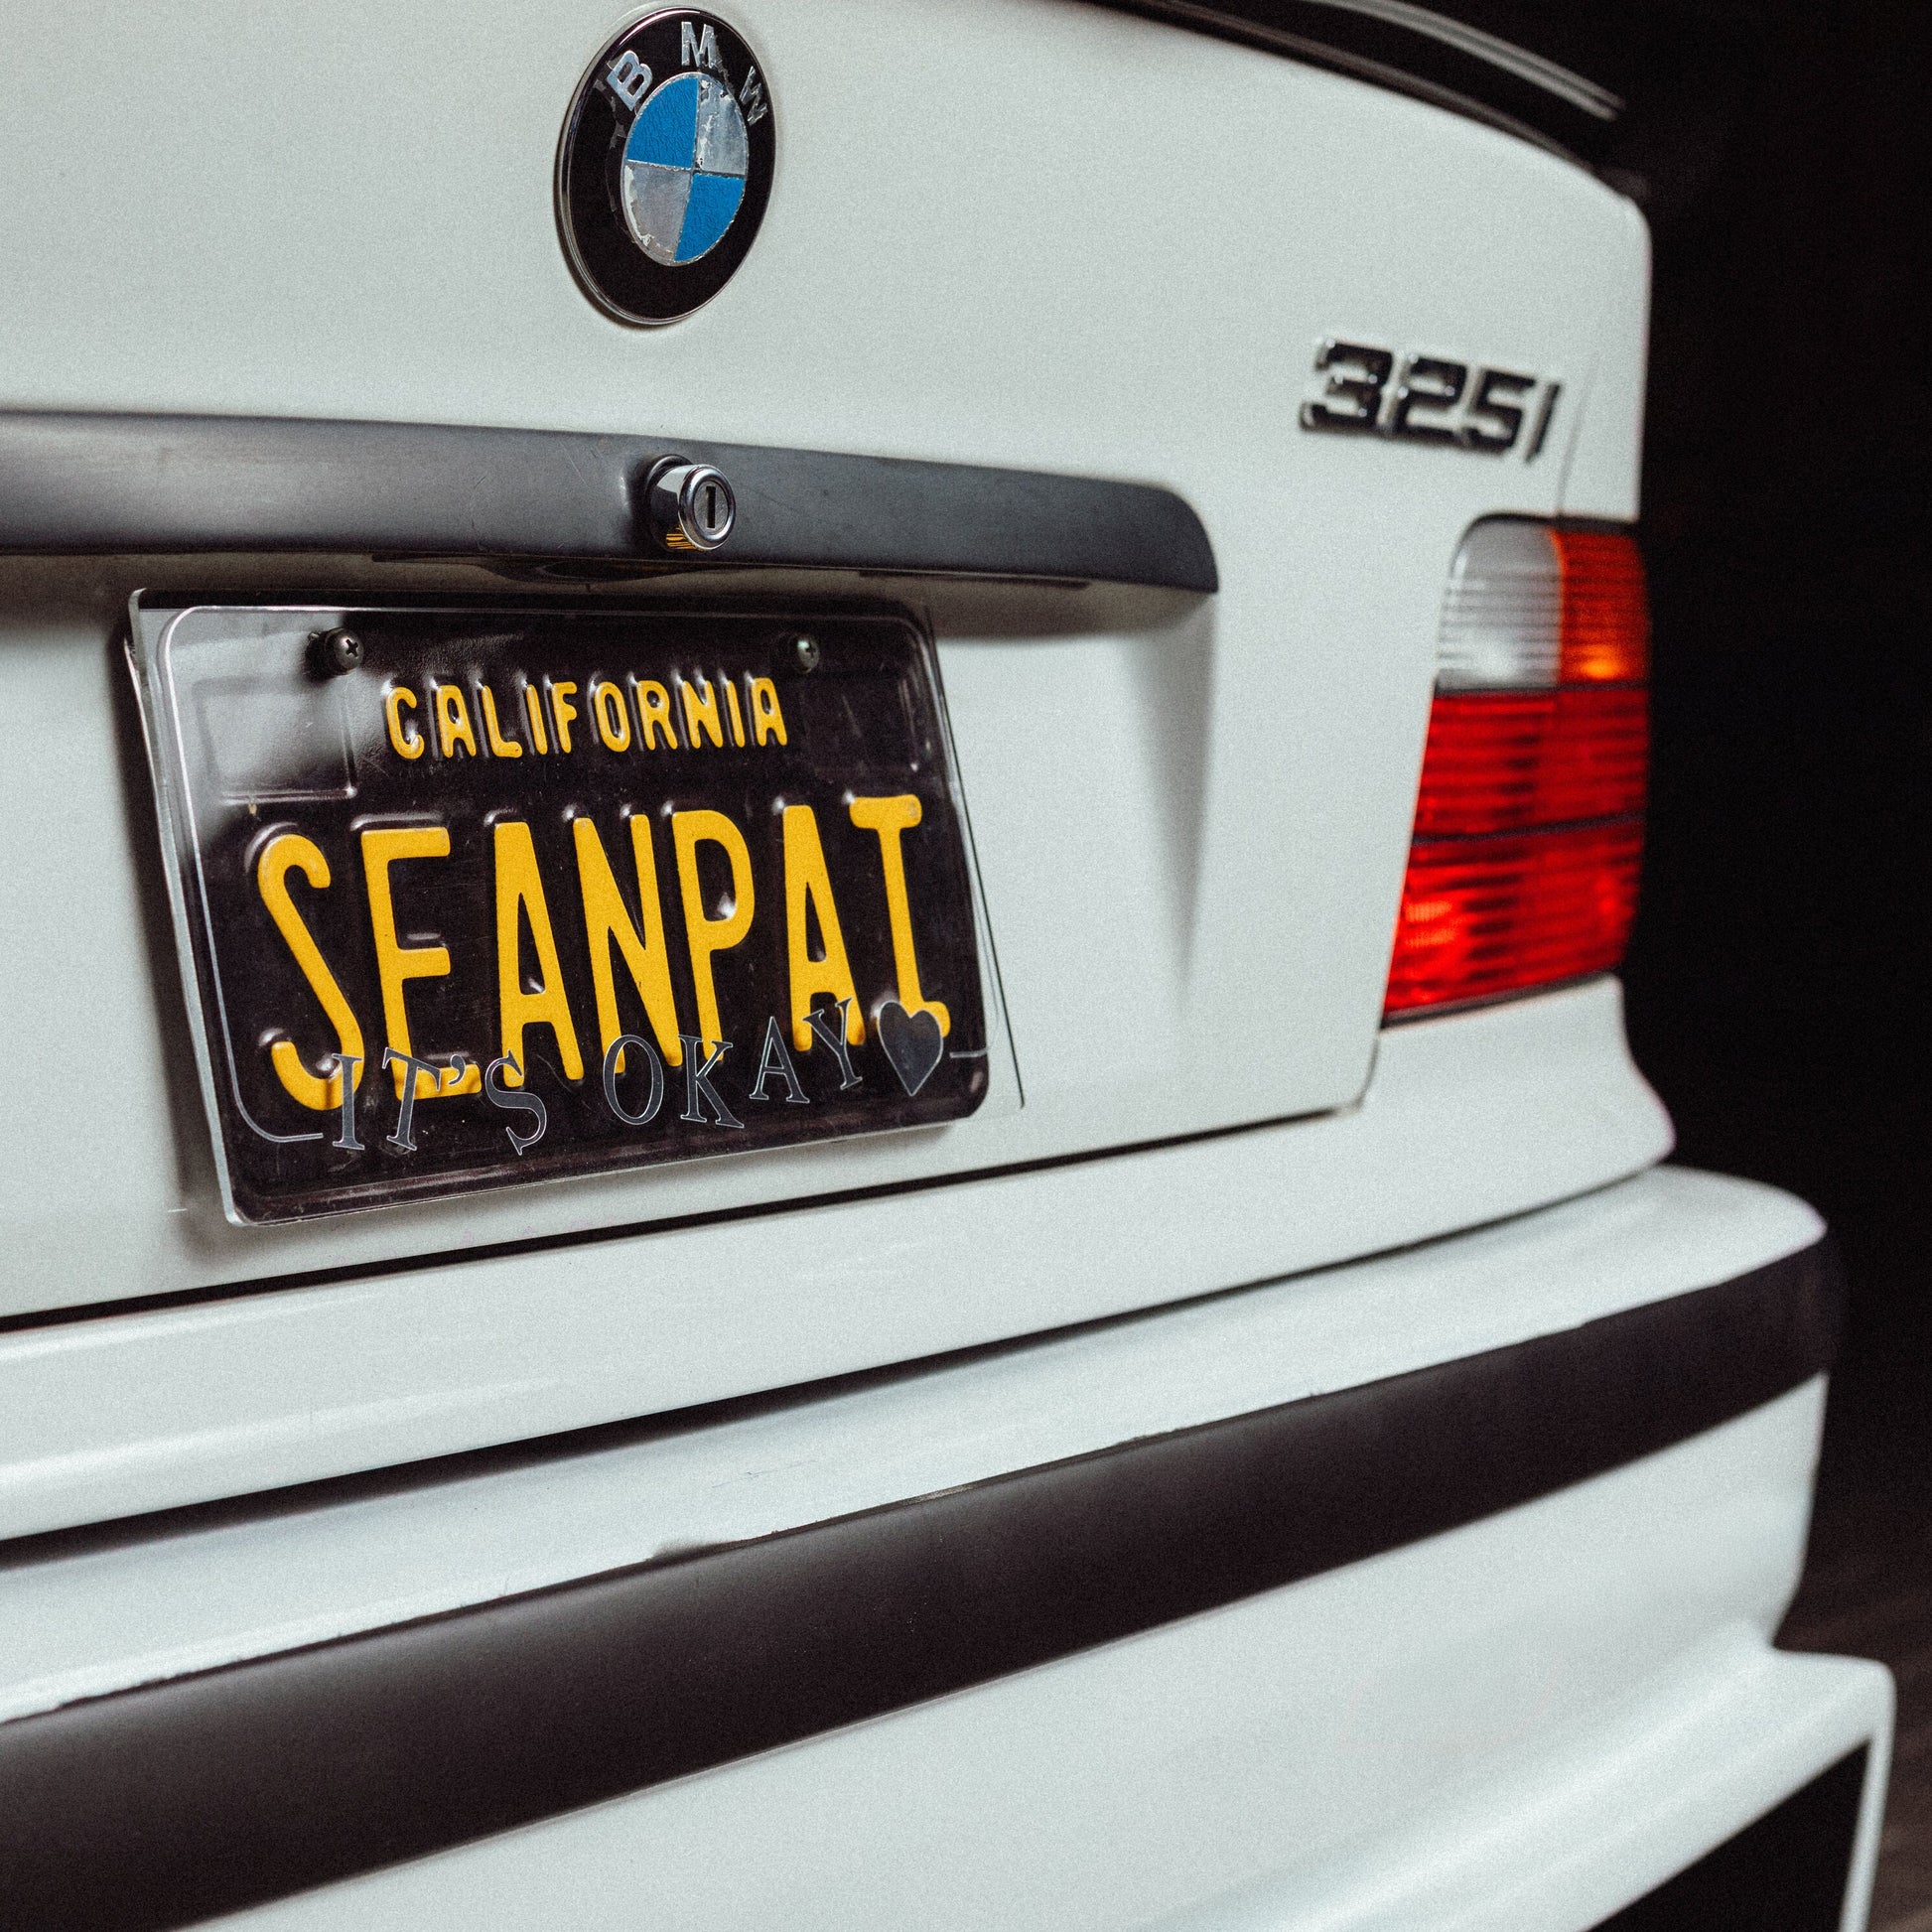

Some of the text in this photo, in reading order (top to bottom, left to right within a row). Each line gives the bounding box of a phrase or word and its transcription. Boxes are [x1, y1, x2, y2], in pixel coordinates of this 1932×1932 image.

[606, 21, 768, 126] BMW
[385, 676, 788, 760] CALIFORNIA
[257, 794, 951, 1112] SEANPAI
[332, 997, 863, 1156] IT'S OKAY
